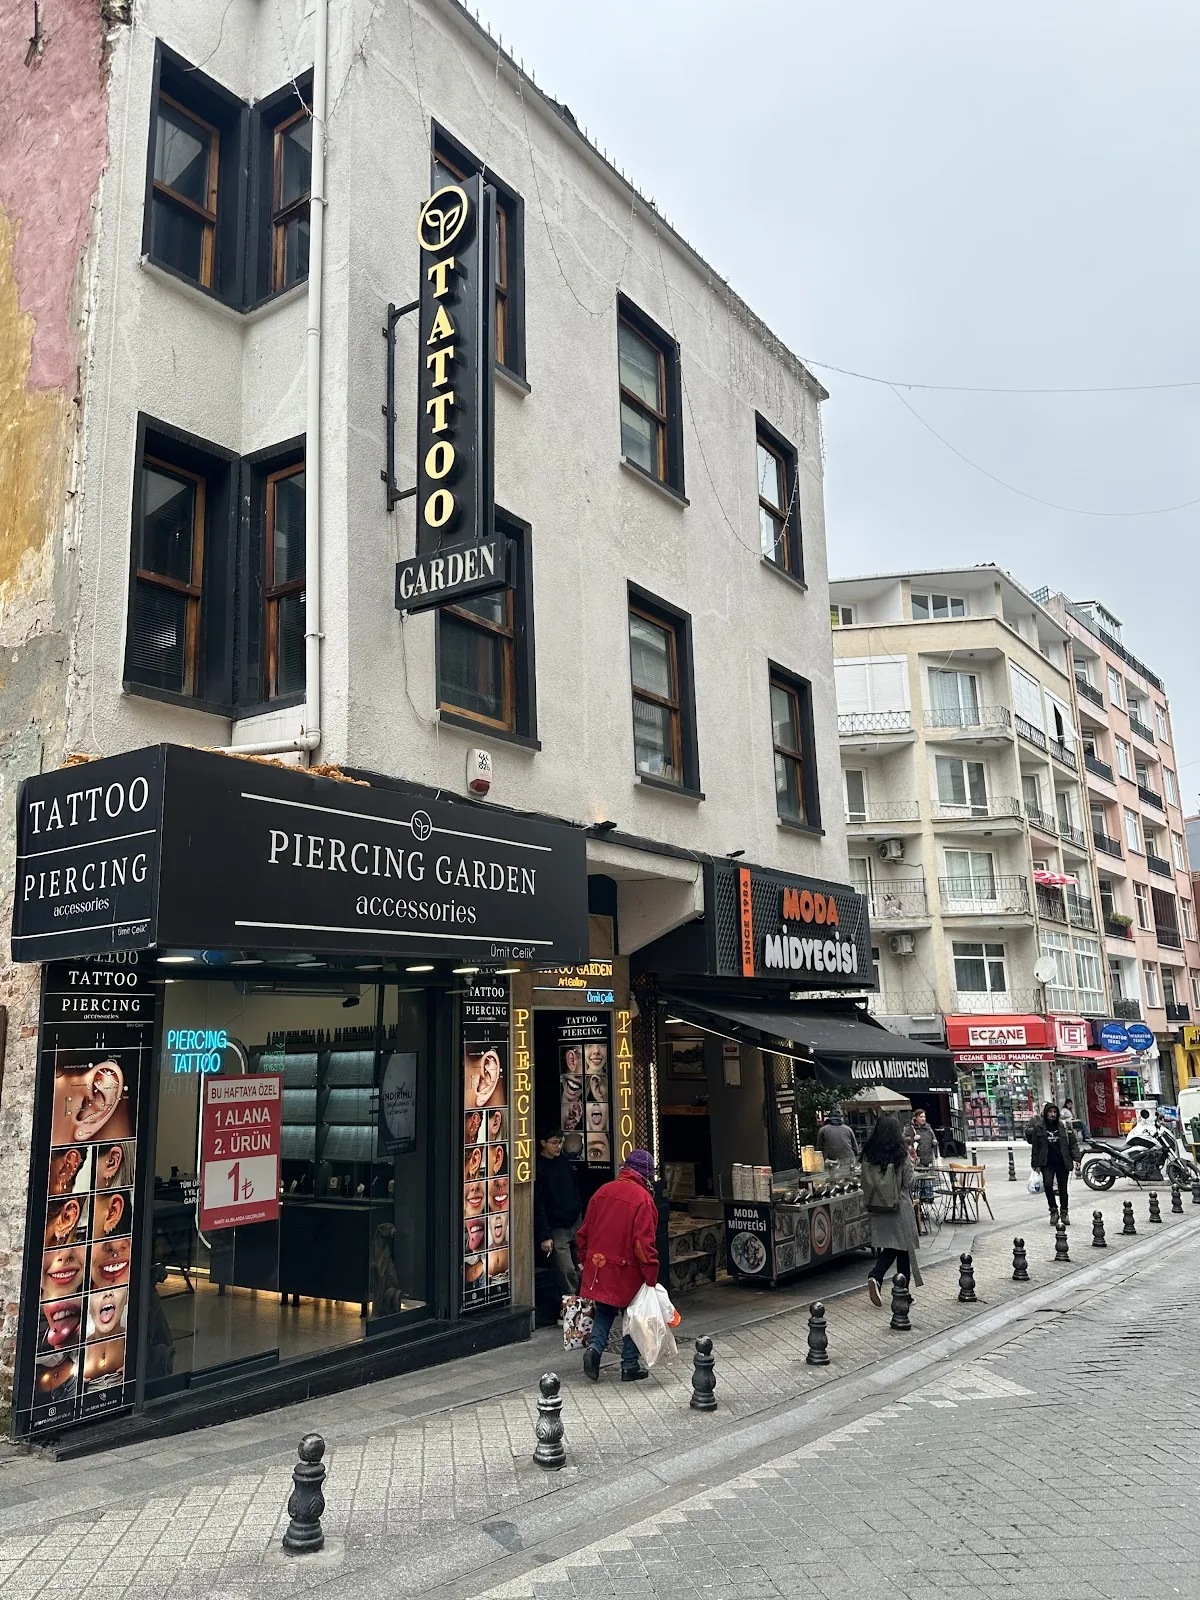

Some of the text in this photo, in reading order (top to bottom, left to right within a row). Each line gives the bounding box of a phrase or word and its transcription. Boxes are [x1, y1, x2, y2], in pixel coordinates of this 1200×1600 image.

[424, 257, 455, 528] TATTOO
[400, 543, 496, 600] GARDEN
[29, 776, 149, 835] TATTOO
[268, 829, 537, 896] PIERCING GARDEN
[23, 853, 148, 901] PIERCING
[53, 897, 110, 917] accessories
[356, 895, 477, 924] accessories
[783, 887, 840, 927] MODA
[490, 943, 510, 958] Ümit
[765, 924, 858, 974] MİDYECİSİ
[68, 970, 138, 987] TATTOO
[470, 986, 505, 998] TATTOO
[61, 998, 141, 1012] PIERCING
[465, 1005, 507, 1016] PIERCING
[566, 1016, 598, 1025] TATTOO
[167, 1029, 227, 1050] PIERCING
[562, 1028, 603, 1038] PIERCING
[970, 1029, 1024, 1040] ECZANE
[171, 1052, 221, 1074] TATTOO
[851, 1057, 929, 1079] MODA MİDYECİSİ
[211, 1082, 277, 1099] BU HAFTAYA ÖZEL
[514, 1009, 532, 1182] PIERCING
[214, 1107, 271, 1127] 1 ALANA
[214, 1131, 271, 1155] 2. ÜRÜN
[733, 1208, 759, 1219] MODA
[728, 1218, 767, 1232] MİDYECİSİ
